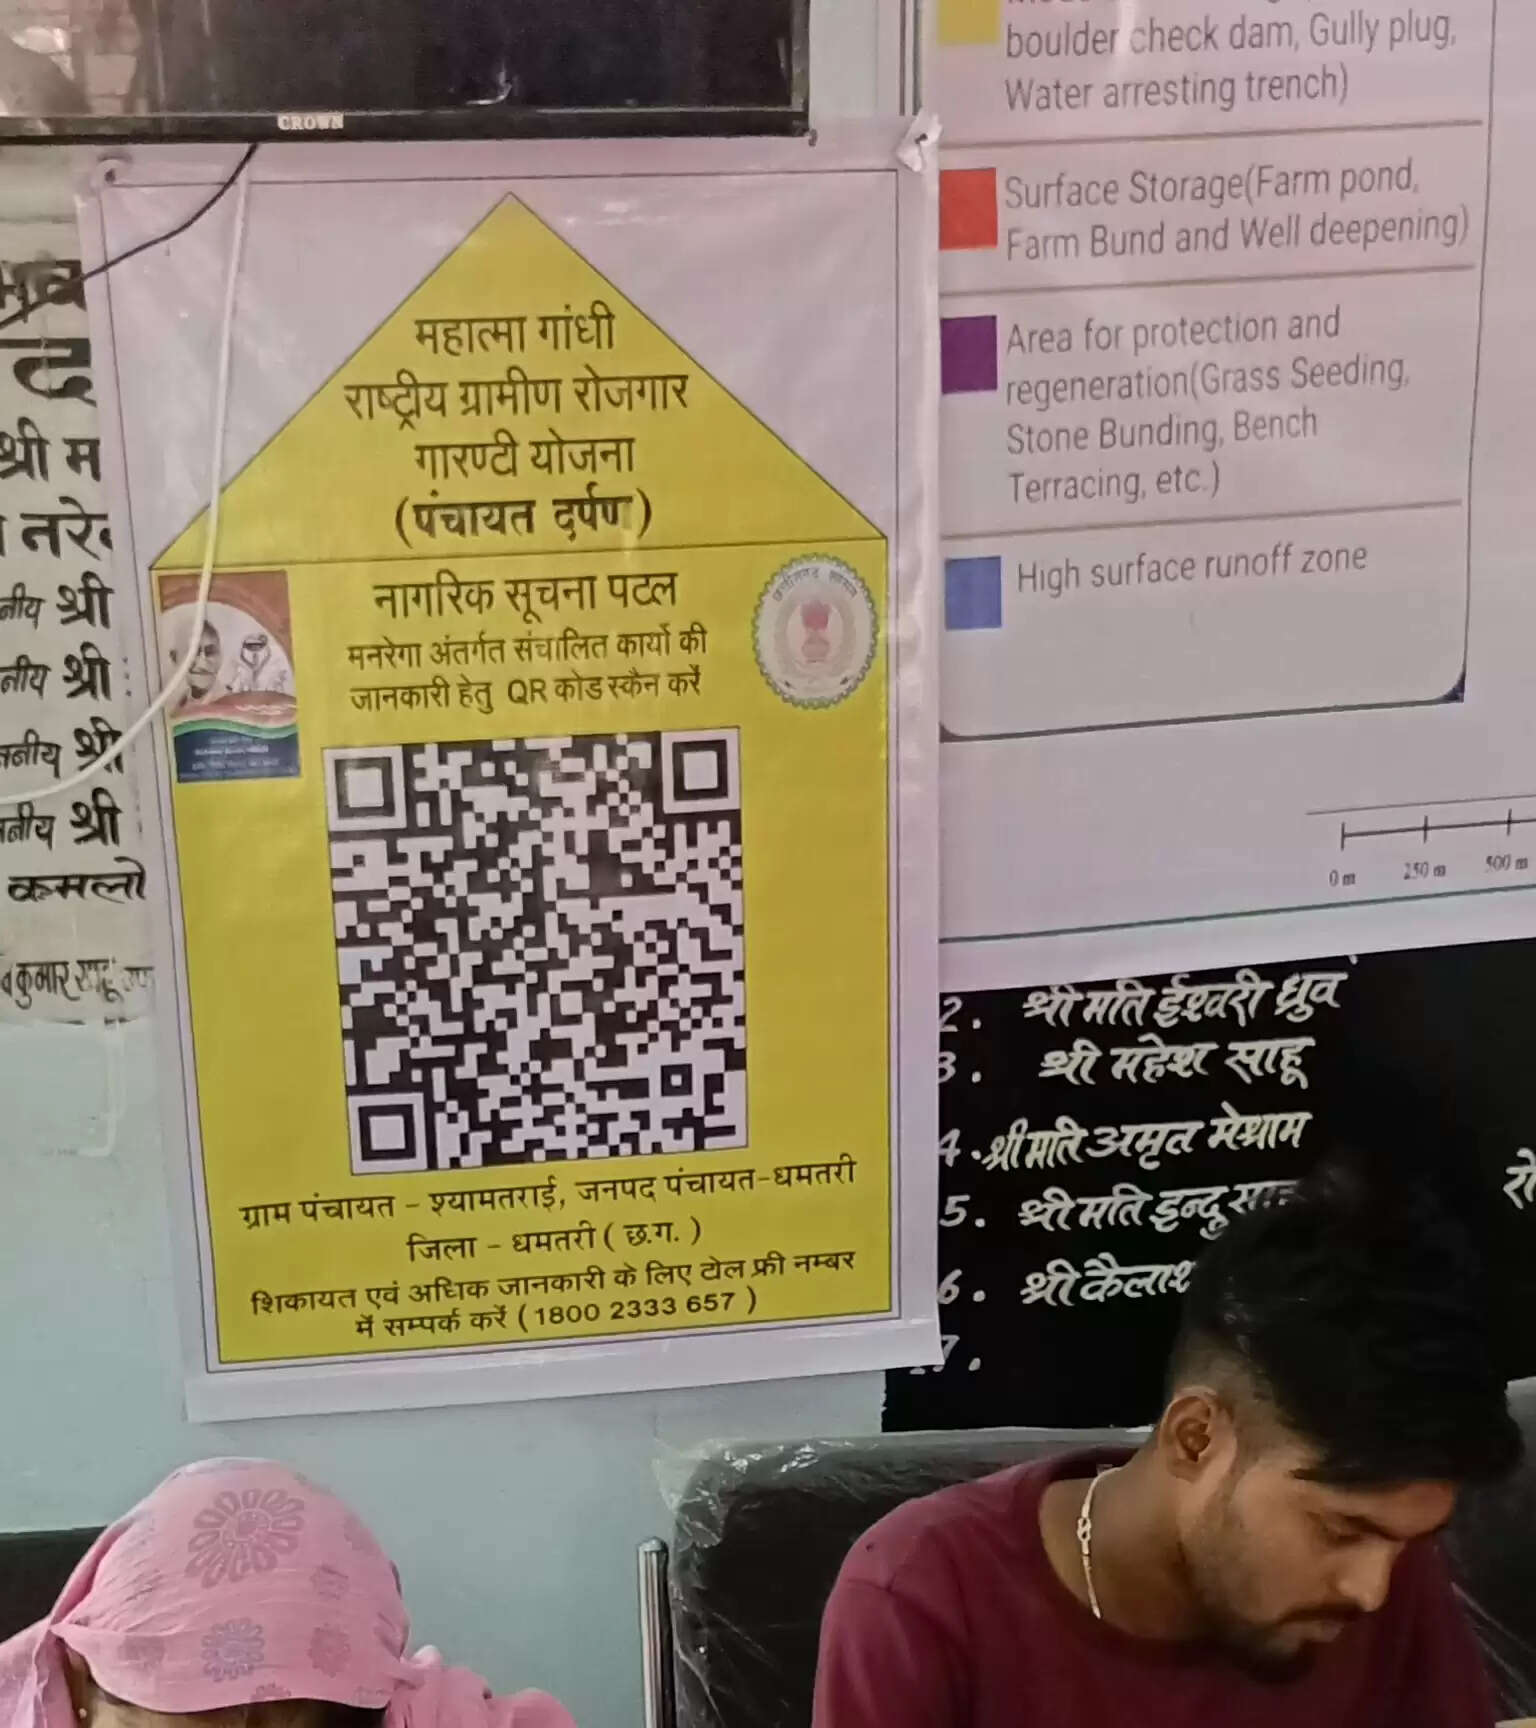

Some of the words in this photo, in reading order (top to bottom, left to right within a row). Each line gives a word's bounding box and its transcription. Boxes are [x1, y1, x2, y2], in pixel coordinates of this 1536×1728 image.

[1005, 23, 1121, 58] boulder
[1129, 15, 1219, 53] check
[1229, 14, 1300, 53] dam,
[1309, 10, 1380, 54] Gully
[1389, 9, 1457, 51] plug,
[1005, 78, 1093, 111] Water
[1103, 71, 1236, 112] arresting
[1245, 62, 1349, 102] trench)
[277, 112, 344, 131] CROWN
[1005, 170, 1120, 209] Surface
[1340, 157, 1421, 197] pond,
[1006, 227, 1080, 262] Farm
[1090, 221, 1164, 258] Bund
[1175, 218, 1229, 253] and
[1240, 213, 1300, 249] Well
[1309, 204, 1470, 251] deepening)
[414, 316, 527, 356] महात्मा
[538, 300, 615, 350] गांधी
[1006, 323, 1073, 355] Area
[1084, 319, 1123, 351] for
[1133, 310, 1278, 357] protection
[1287, 305, 1341, 340] and
[343, 369, 448, 430] राष्ट्रीय
[459, 365, 562, 418] ग्रामीण
[573, 364, 688, 412] रोजगार
[1290, 353, 1410, 392] Seeding,
[415, 428, 518, 479] गारण्टी
[529, 427, 635, 474] योजना
[1006, 419, 1089, 455] Stone
[1099, 412, 1225, 452] Bunding,
[1234, 407, 1318, 442] Bench
[1008, 468, 1147, 504] Terracing,
[373, 569, 494, 619] नागरिक
[505, 575, 597, 624] सूचना
[608, 572, 678, 608] पटल
[1016, 559, 1080, 598] High
[1091, 551, 1195, 590] surface
[1204, 543, 1295, 580] runoff
[1301, 543, 1369, 574] zone
[57, 571, 116, 630] श्री
[63, 642, 113, 701] श्री
[348, 635, 422, 670] मनरेगा
[430, 629, 505, 666] अंतर्गत
[513, 625, 608, 663] संचालित
[679, 621, 708, 655] की
[349, 675, 450, 713] जानकारी
[456, 673, 495, 714] हेतु
[507, 678, 548, 705] QR
[553, 668, 603, 703] कोड
[607, 667, 660, 701] स्कैन
[70, 787, 123, 847] श्री
[1038, 1037, 1102, 1085] श्री
[1110, 1032, 1219, 1084] महेश
[1225, 1037, 1316, 1089] साहू
[1086, 1121, 1205, 1170] अमृत
[239, 1201, 291, 1230] ग्राम
[298, 1192, 396, 1223] पंचायत
[574, 1176, 657, 1203] जनपद
[406, 1232, 478, 1262] जिला
[512, 1220, 596, 1254] धमतरी
[251, 1287, 357, 1316] शिकायत
[365, 1280, 400, 1310] एवं
[409, 1276, 490, 1306] अधिक
[498, 1264, 605, 1298] जानकारी
[614, 1263, 637, 1289] के
[646, 1259, 692, 1287] लिए
[700, 1256, 747, 1282] टोल
[751, 1251, 786, 1278] फ्री
[794, 1250, 856, 1271] नम्बर
[1020, 1258, 1082, 1306] श्री
[384, 1308, 461, 1337] सम्पर्क
[535, 1303, 600, 1326] 1800
[610, 1297, 677, 1321] 2333
[686, 1292, 735, 1313] 657
